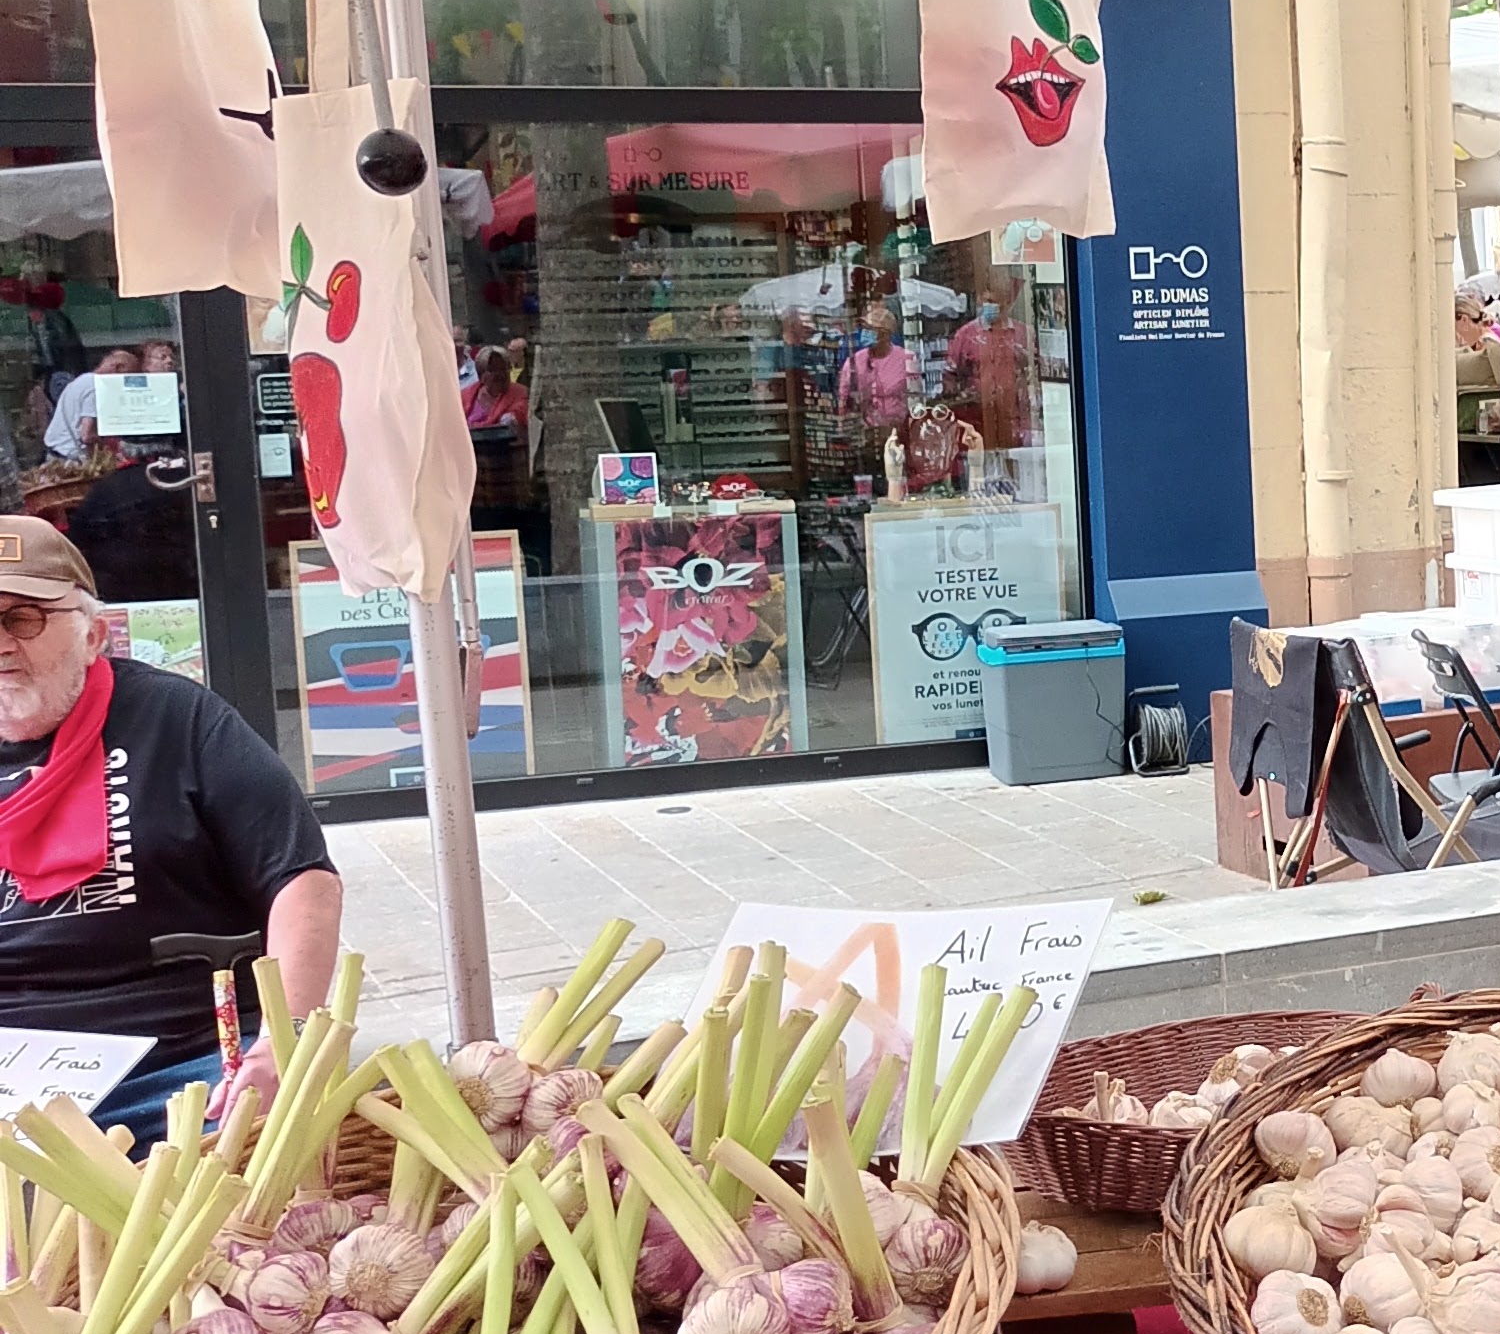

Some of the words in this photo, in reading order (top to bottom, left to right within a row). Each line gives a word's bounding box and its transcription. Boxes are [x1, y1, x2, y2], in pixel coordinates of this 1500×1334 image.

[658, 170, 750, 191] MESURE
[1160, 287, 1209, 303] DUMAS
[935, 522, 995, 564] ICI
[641, 556, 766, 593] BOZ
[934, 567, 999, 585] TESTEZ
[917, 587, 977, 603] VOTRE
[982, 583, 1019, 599] VUE
[932, 669, 945, 679] et
[932, 701, 952, 711] vos
[935, 925, 992, 966] Ail
[1019, 921, 1082, 957] Frais
[38, 1047, 102, 1070] Frais
